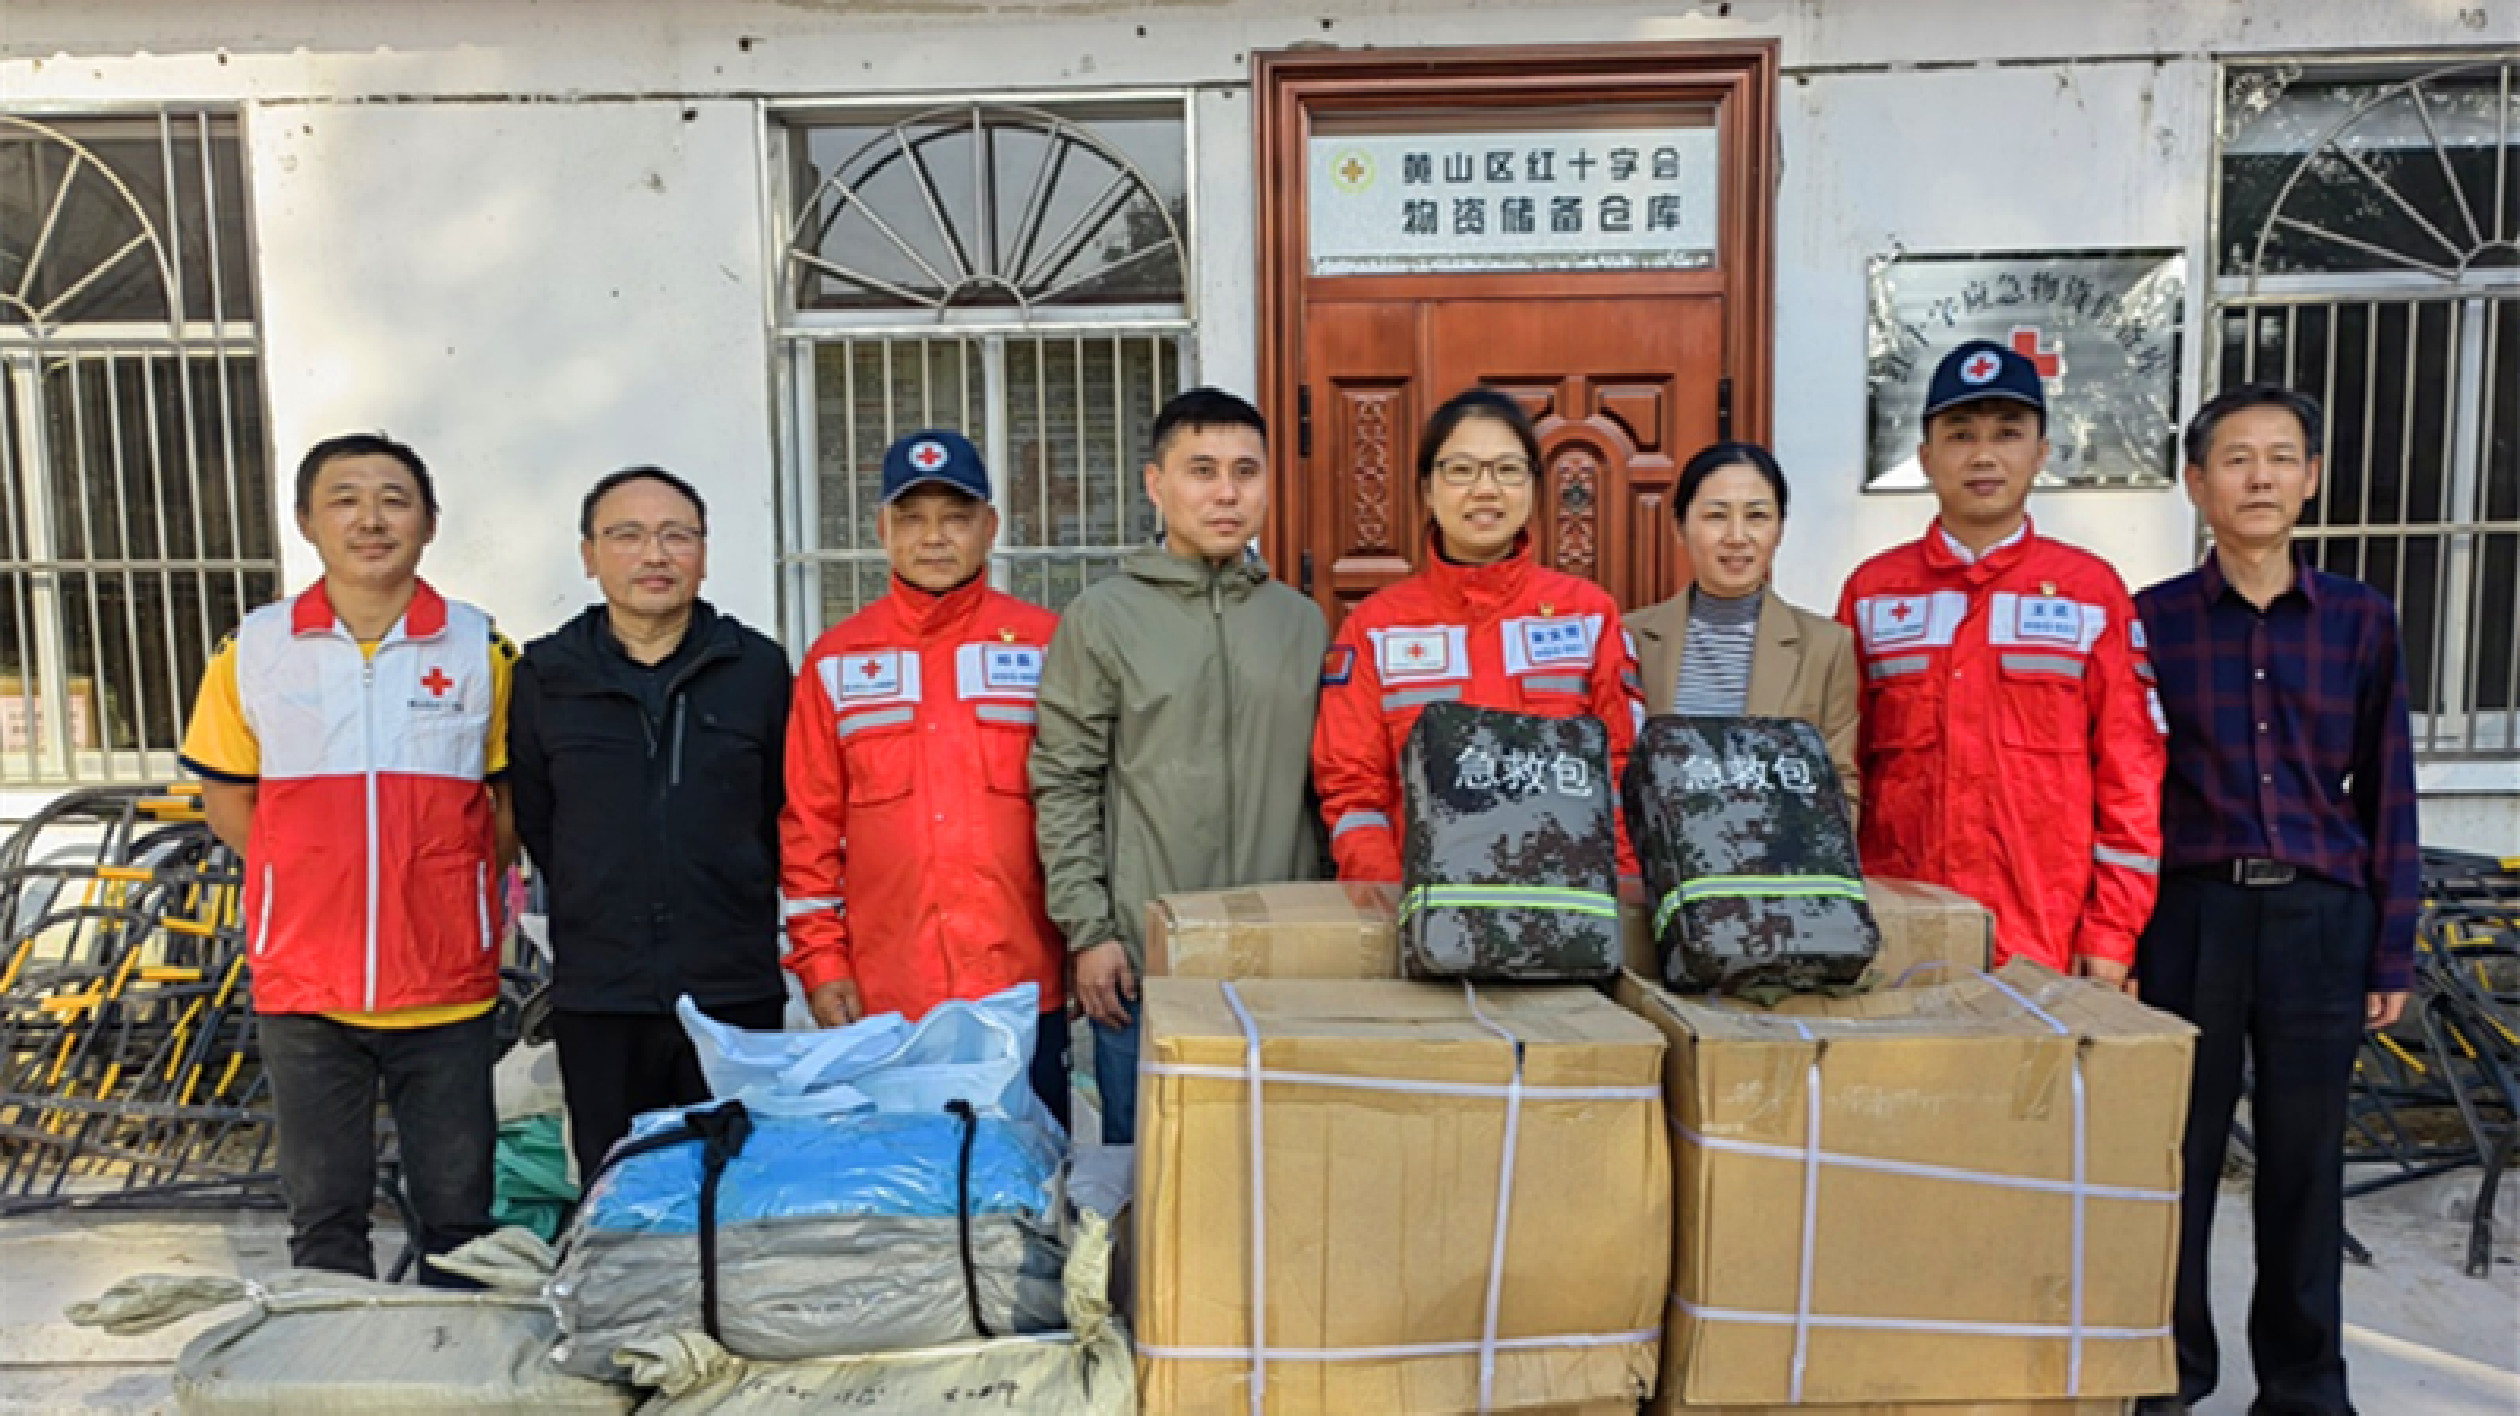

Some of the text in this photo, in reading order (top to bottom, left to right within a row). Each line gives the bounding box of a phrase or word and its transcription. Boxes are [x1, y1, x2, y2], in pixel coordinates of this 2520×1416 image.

[1402, 146, 1680, 185] 黄山区红十字会
[1402, 194, 1681, 235] 物资储备仓库
[1455, 746, 1593, 797] 急救包
[1682, 754, 1817, 794] 急救包
